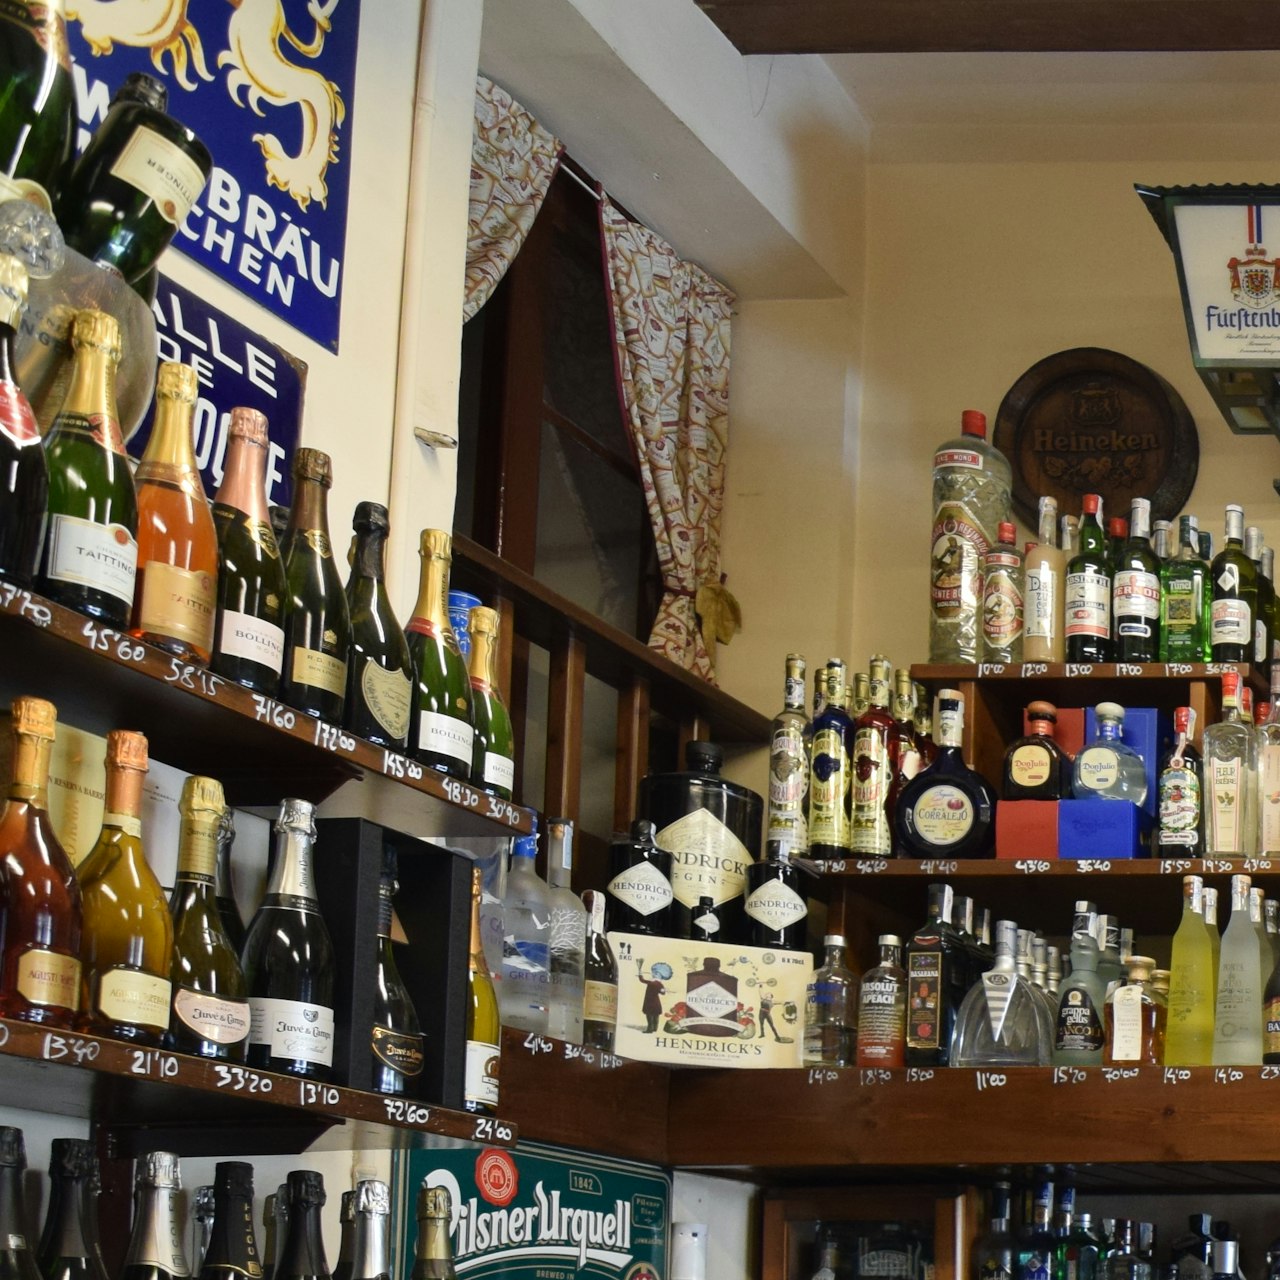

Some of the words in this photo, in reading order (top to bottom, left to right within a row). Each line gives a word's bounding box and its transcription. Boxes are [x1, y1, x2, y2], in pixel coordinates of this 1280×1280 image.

[1033, 428, 1158, 454] Heineken
[1116, 664, 1143, 678] 17'00
[253, 694, 295, 730] 71'60
[313, 720, 355, 754] 172'00
[442, 777, 479, 807] 48'30
[918, 810, 967, 822] CORRALEJO
[1160, 860, 1191, 873] 15'50
[862, 982, 899, 993] ABSOLUT
[863, 995, 895, 1004] APEACH
[656, 1037, 761, 1055] HENDRICK'S
[131, 1051, 179, 1077] 21'10
[976, 1072, 1006, 1089] 11'00
[299, 1081, 339, 1106] 13'10
[384, 1101, 429, 1124] 72'60
[475, 1120, 512, 1142] 24'00
[574, 1175, 594, 1187] 1842
[533, 1185, 632, 1268] Urquell
[536, 1271, 561, 1280] BREWED
[564, 1272, 574, 1280] IN
